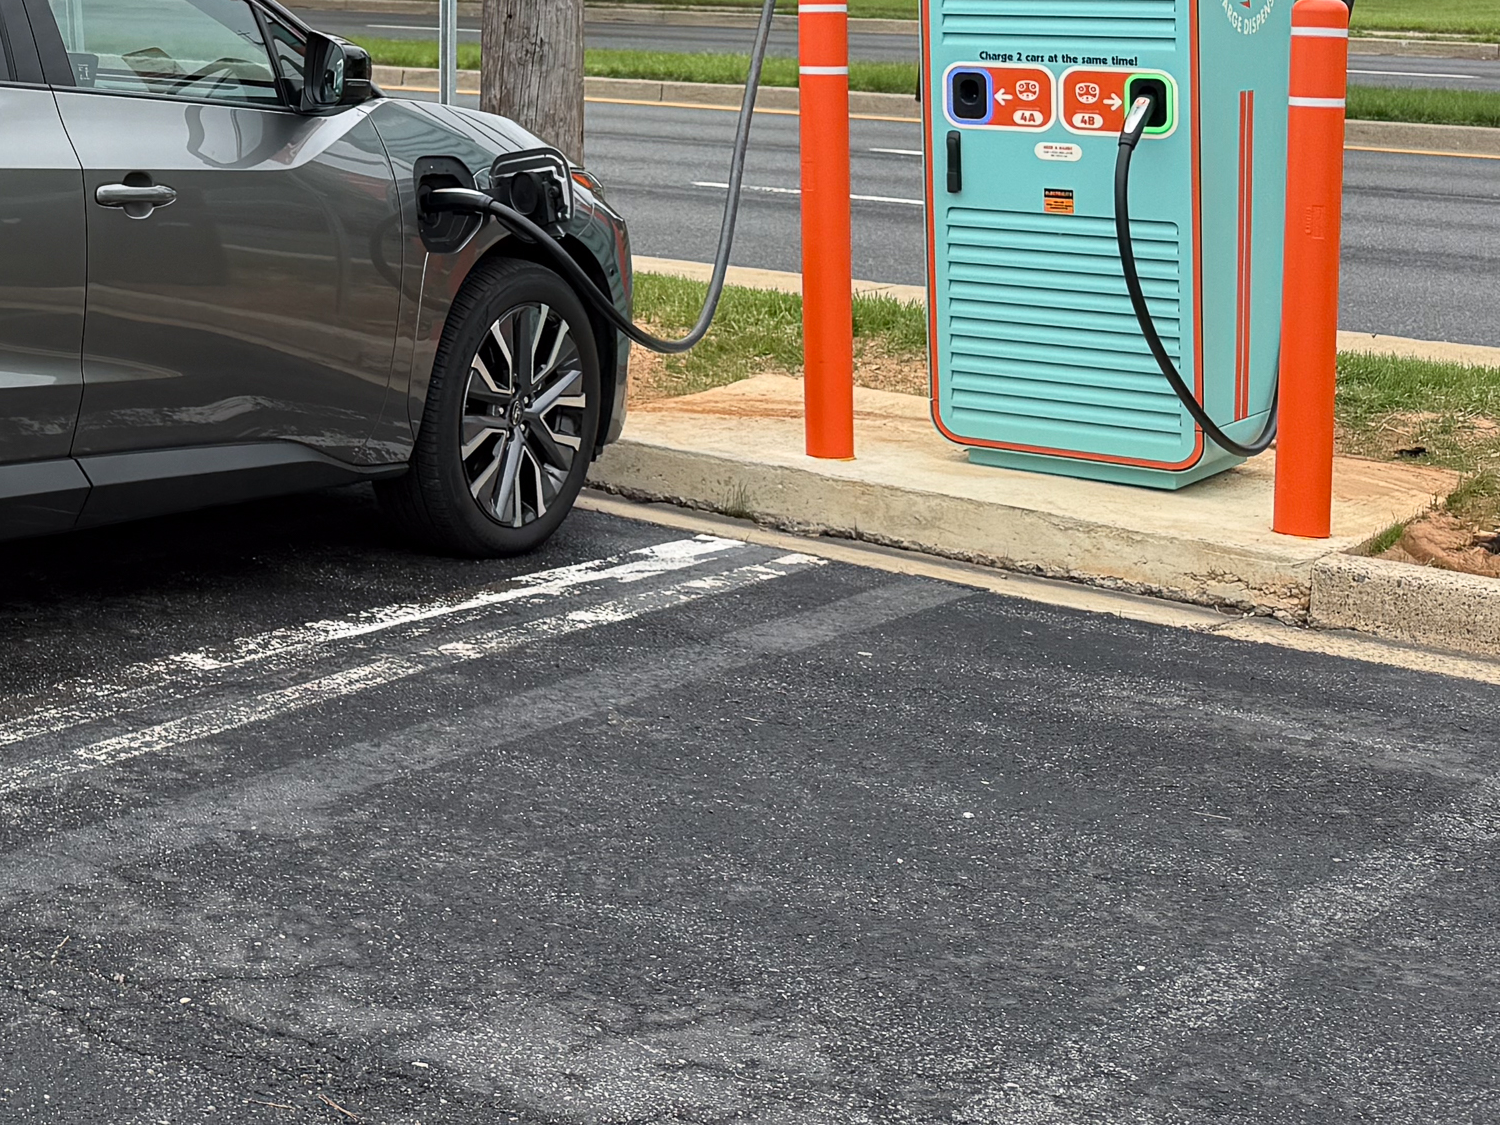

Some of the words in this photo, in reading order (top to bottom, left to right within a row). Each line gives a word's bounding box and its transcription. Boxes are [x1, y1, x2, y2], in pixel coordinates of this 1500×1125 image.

[979, 50, 1013, 63] Charge
[1016, 52, 1023, 62] 2
[1025, 54, 1045, 63] cars
[1047, 54, 1058, 63] at
[1061, 54, 1078, 64] the
[1081, 57, 1108, 65] same
[1111, 56, 1138, 66] time!
[1020, 112, 1036, 123] 4A
[1080, 115, 1095, 126] 4B
